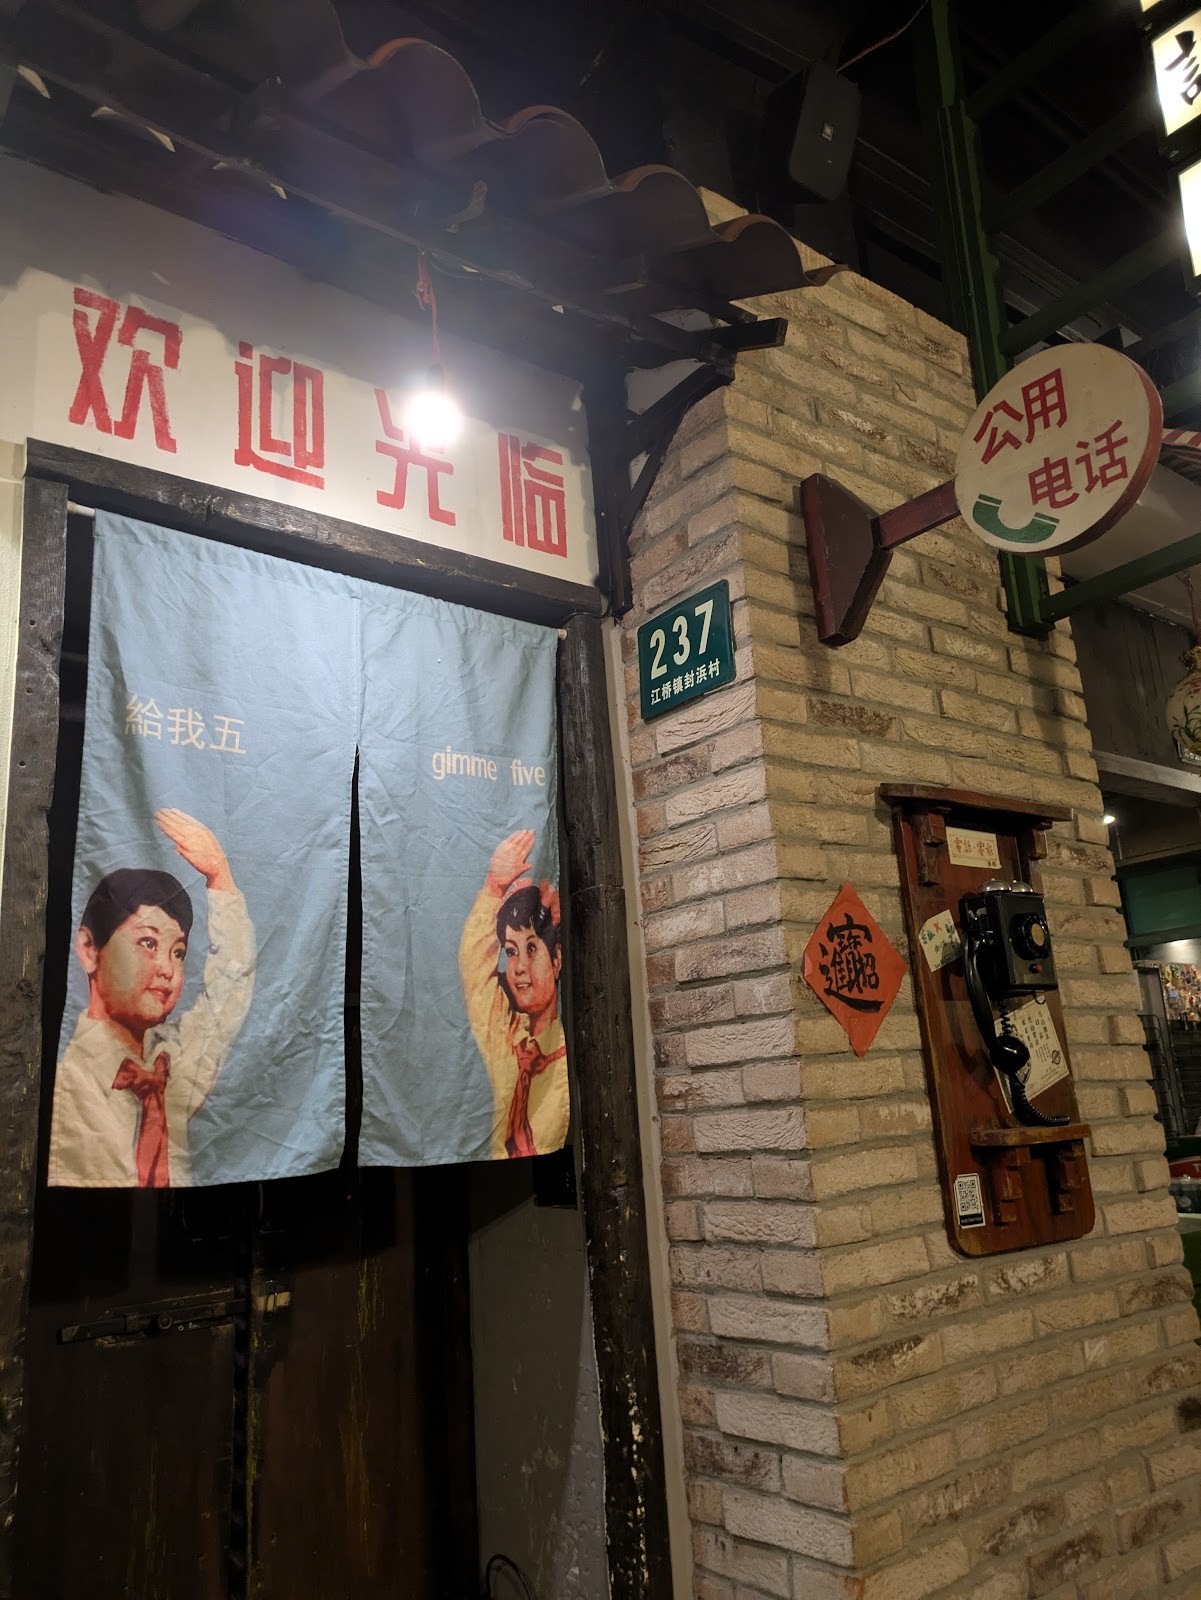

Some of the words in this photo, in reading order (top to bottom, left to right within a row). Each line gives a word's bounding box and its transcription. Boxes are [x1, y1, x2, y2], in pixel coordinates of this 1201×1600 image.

[67, 286, 568, 558] 欢迎光临
[973, 366, 1068, 466] 公用
[1026, 418, 1129, 509] 电话
[649, 598, 714, 681] 237
[125, 688, 247, 755] 給我五
[650, 657, 721, 706] 江桥镇封浜村
[432, 744, 498, 788] gimme
[509, 758, 546, 787] five
